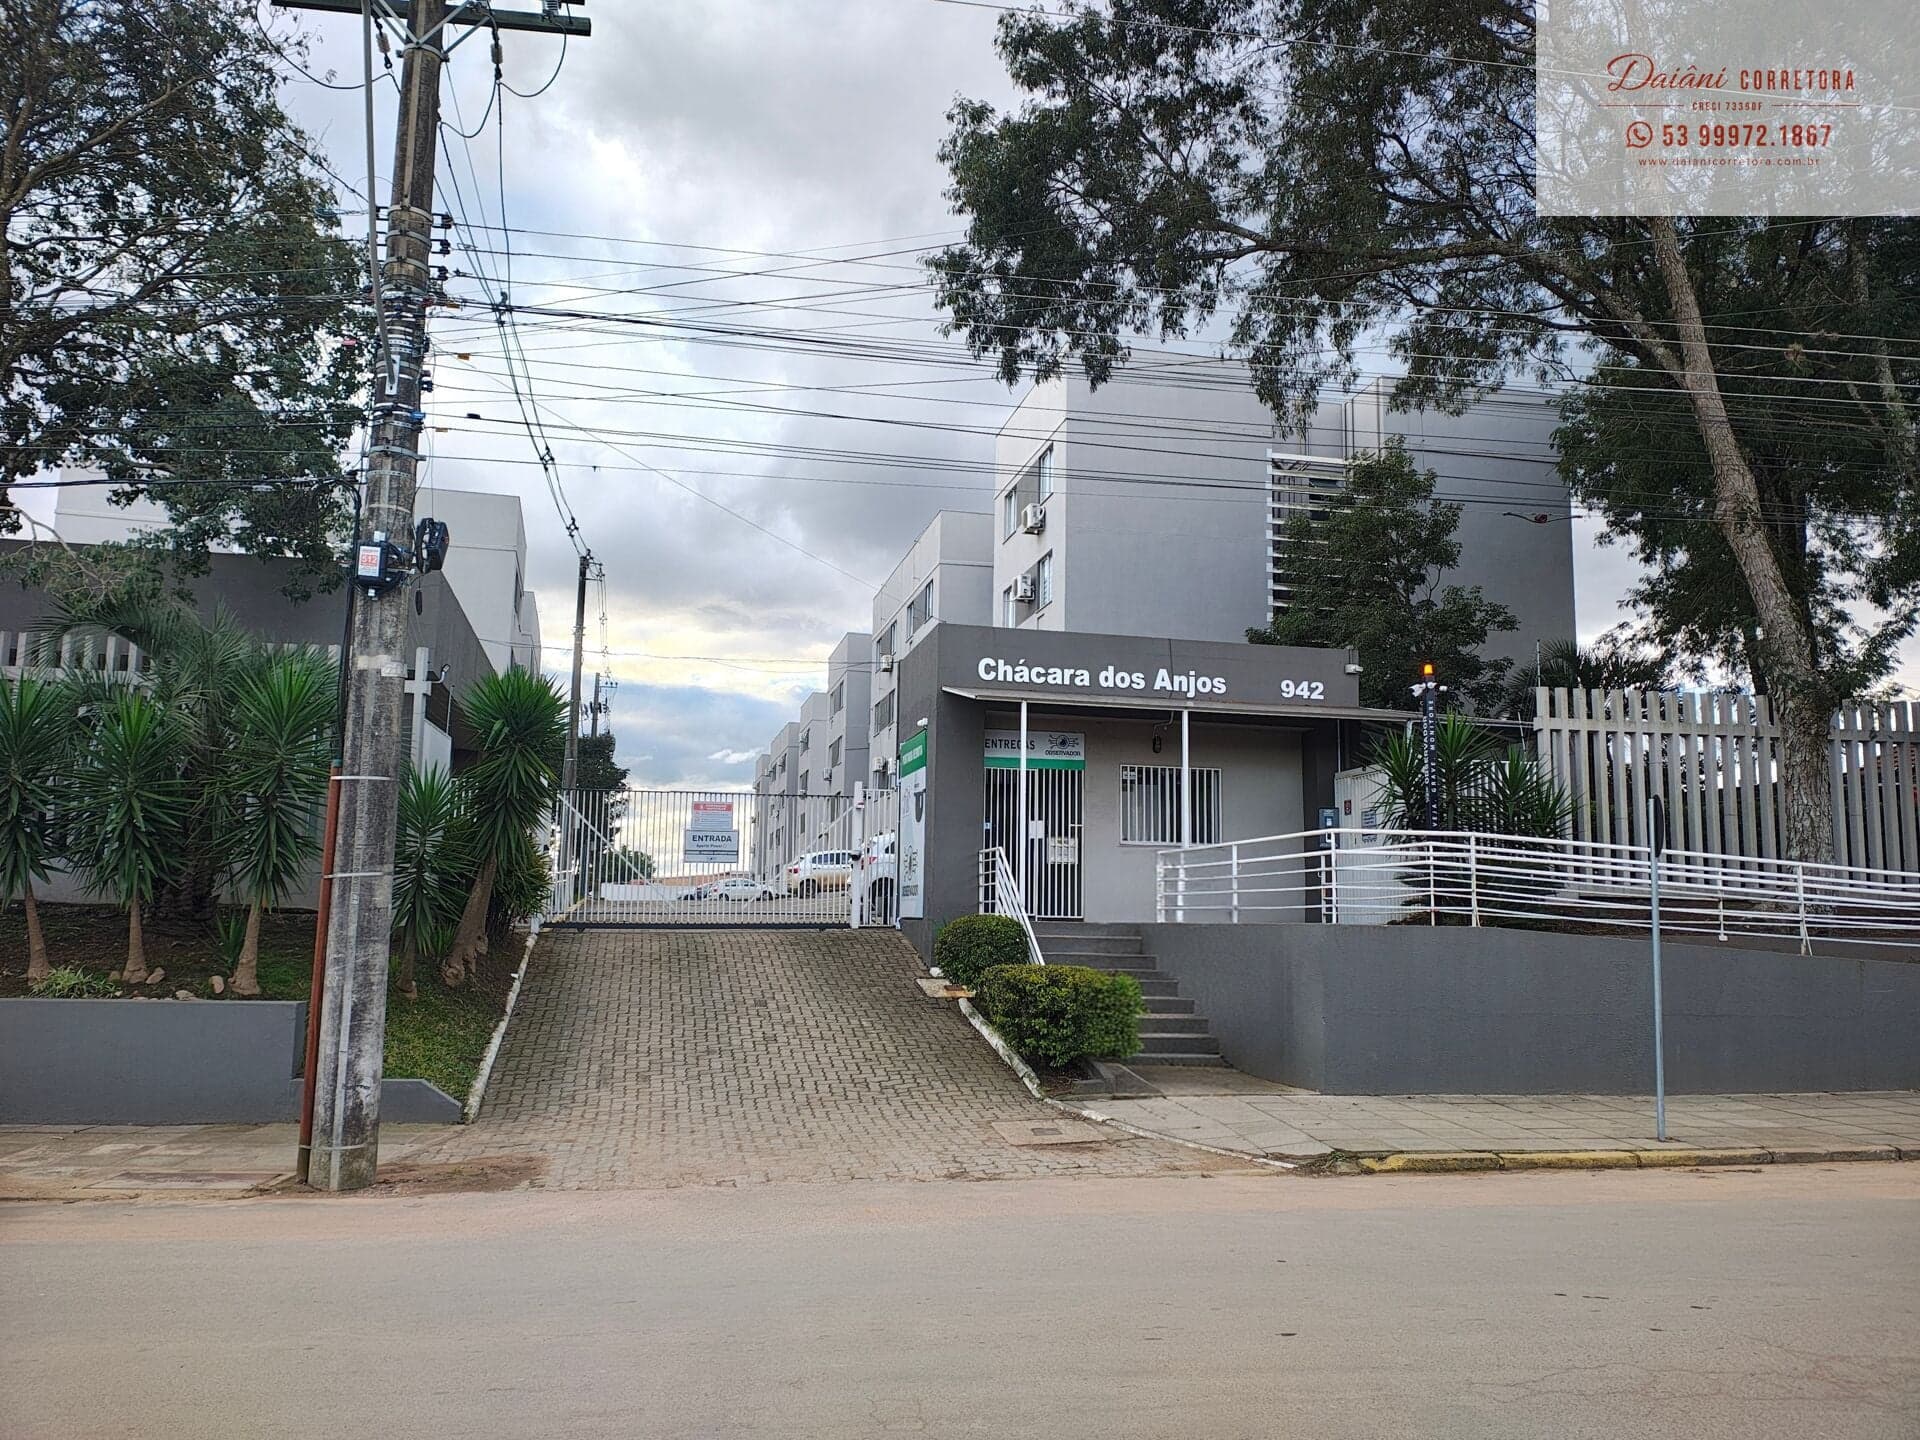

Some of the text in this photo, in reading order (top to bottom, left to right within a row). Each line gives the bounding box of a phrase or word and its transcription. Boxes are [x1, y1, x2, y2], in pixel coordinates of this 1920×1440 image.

[977, 657, 1227, 698] Chácara dos Anjos
[1280, 680, 1325, 700] 942
[692, 834, 732, 842] ENTRADA
